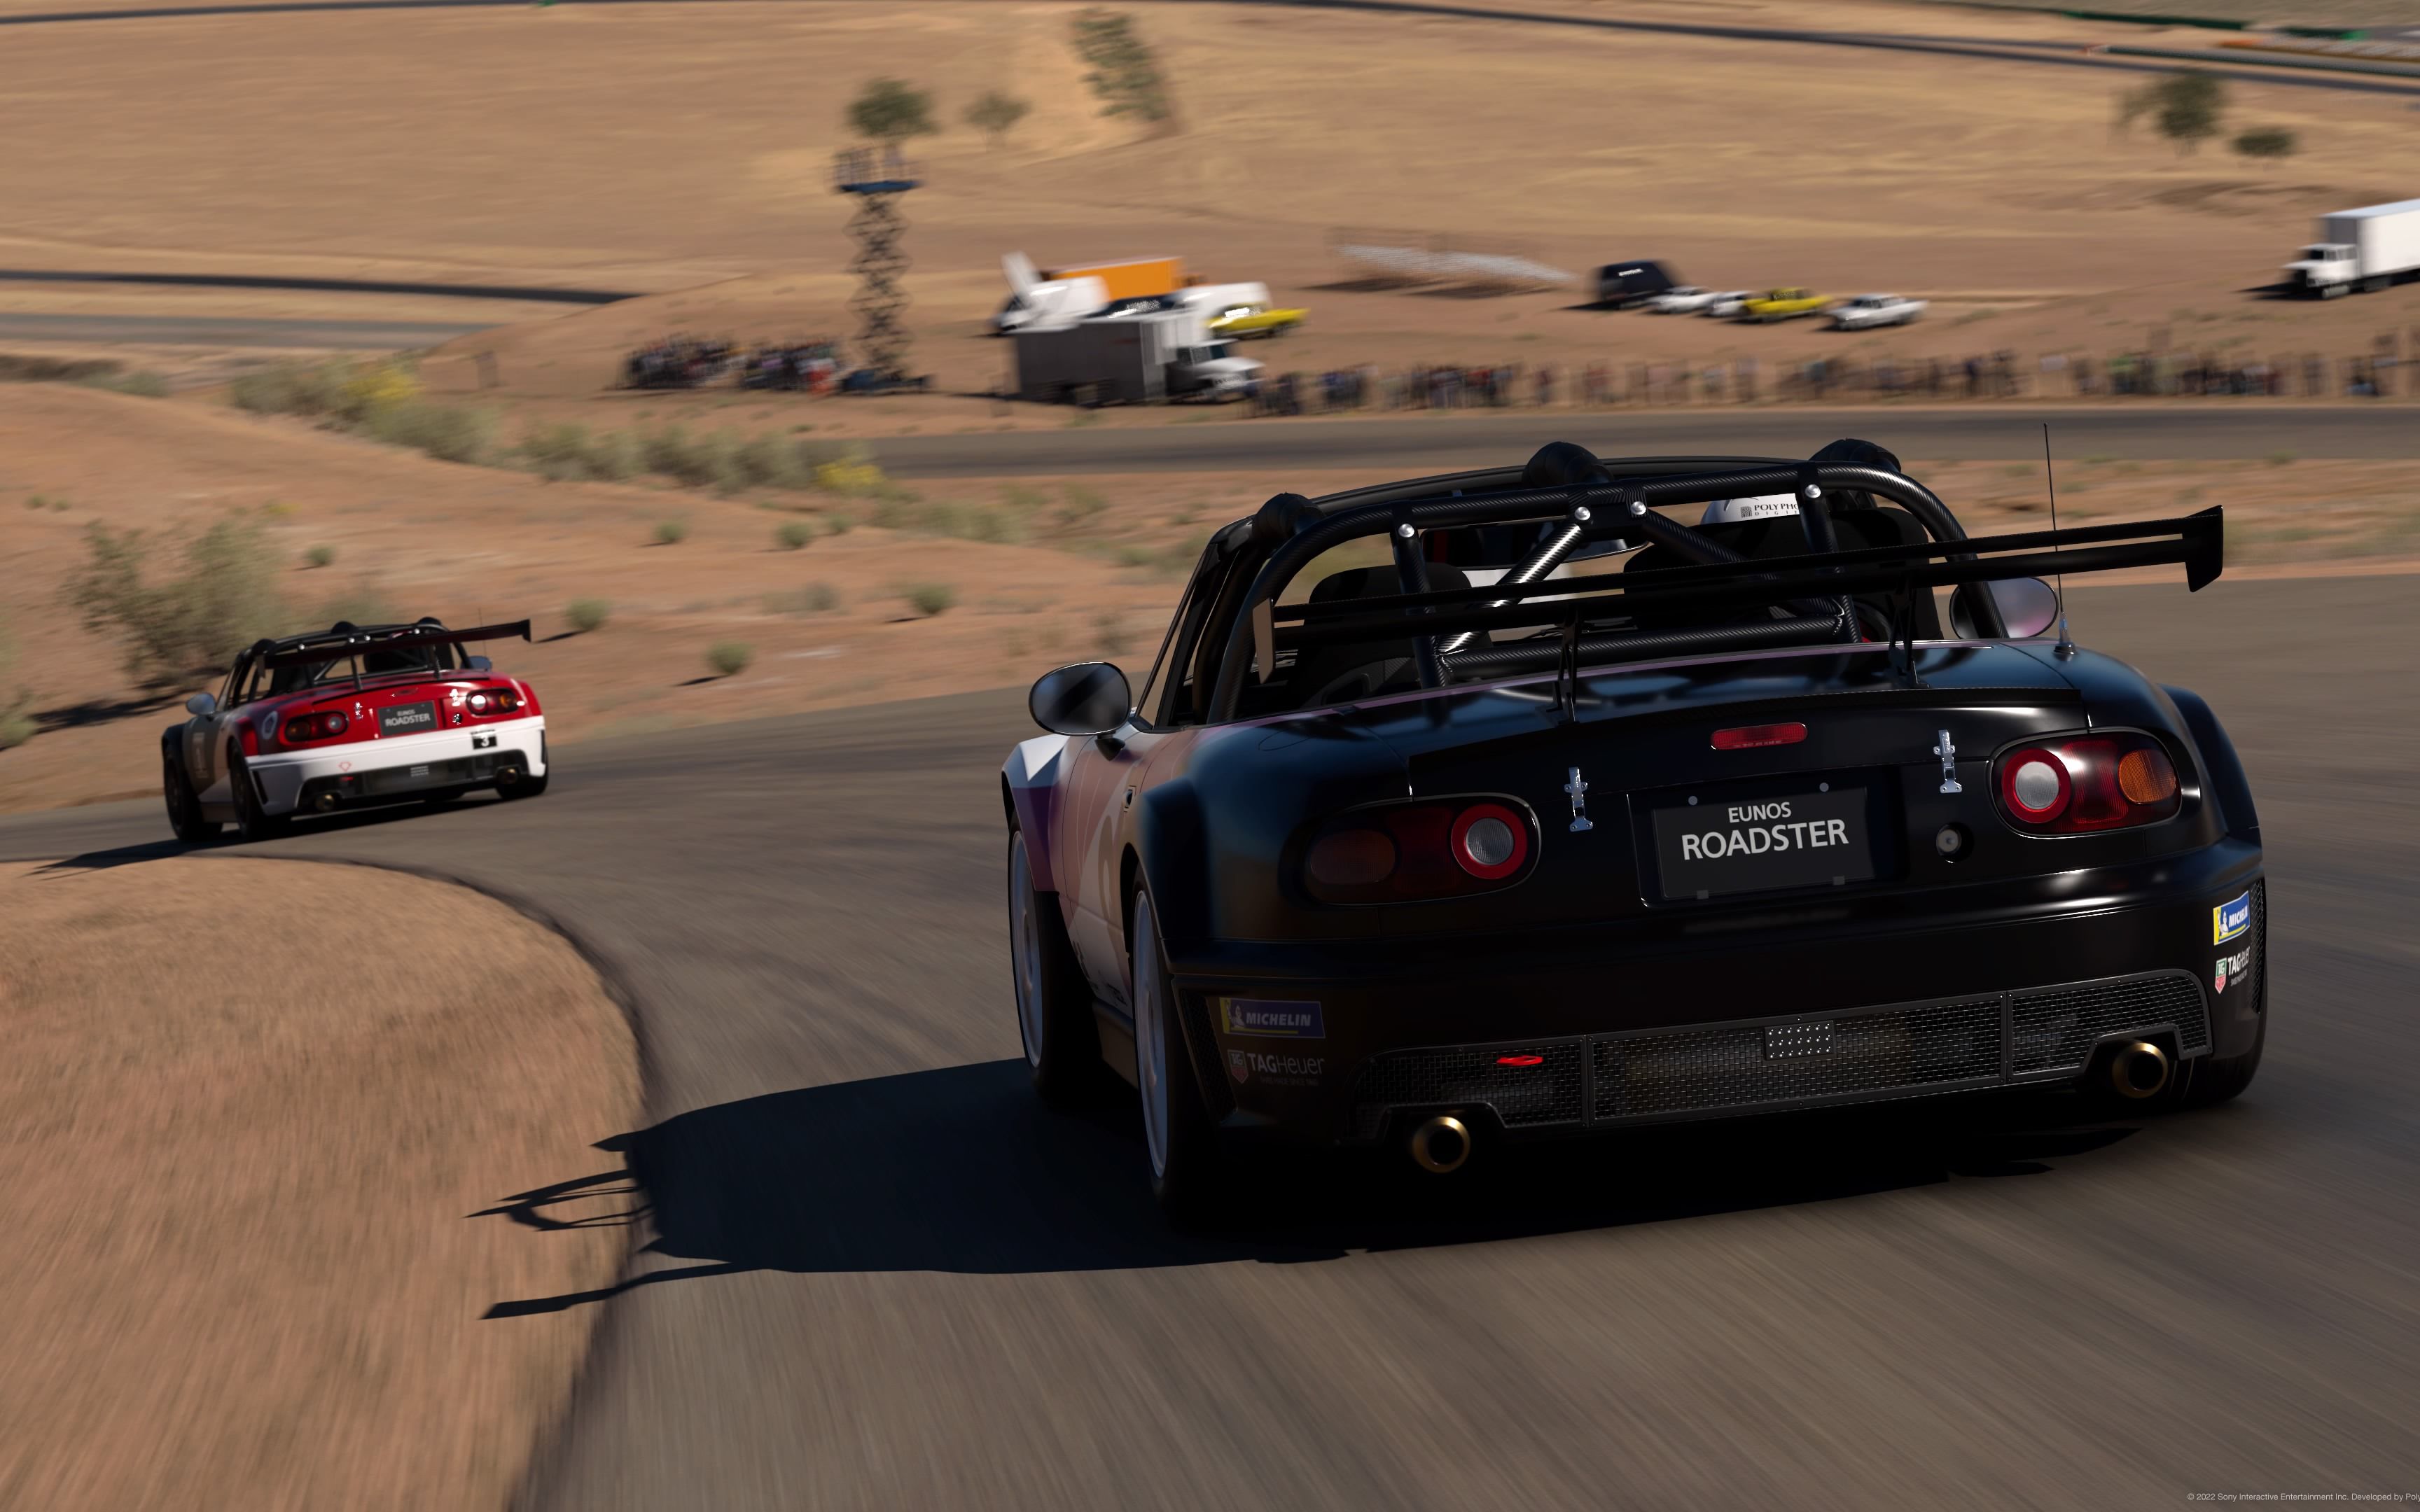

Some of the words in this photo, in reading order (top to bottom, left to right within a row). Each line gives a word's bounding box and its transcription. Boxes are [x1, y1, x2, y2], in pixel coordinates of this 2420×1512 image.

[384, 713, 431, 727] ROADSTER
[481, 736, 489, 748] 3
[1728, 802, 1792, 823] EUNOS
[1681, 819, 1849, 860] ROADSTER
[1246, 1011, 1311, 1027] MICHELIN
